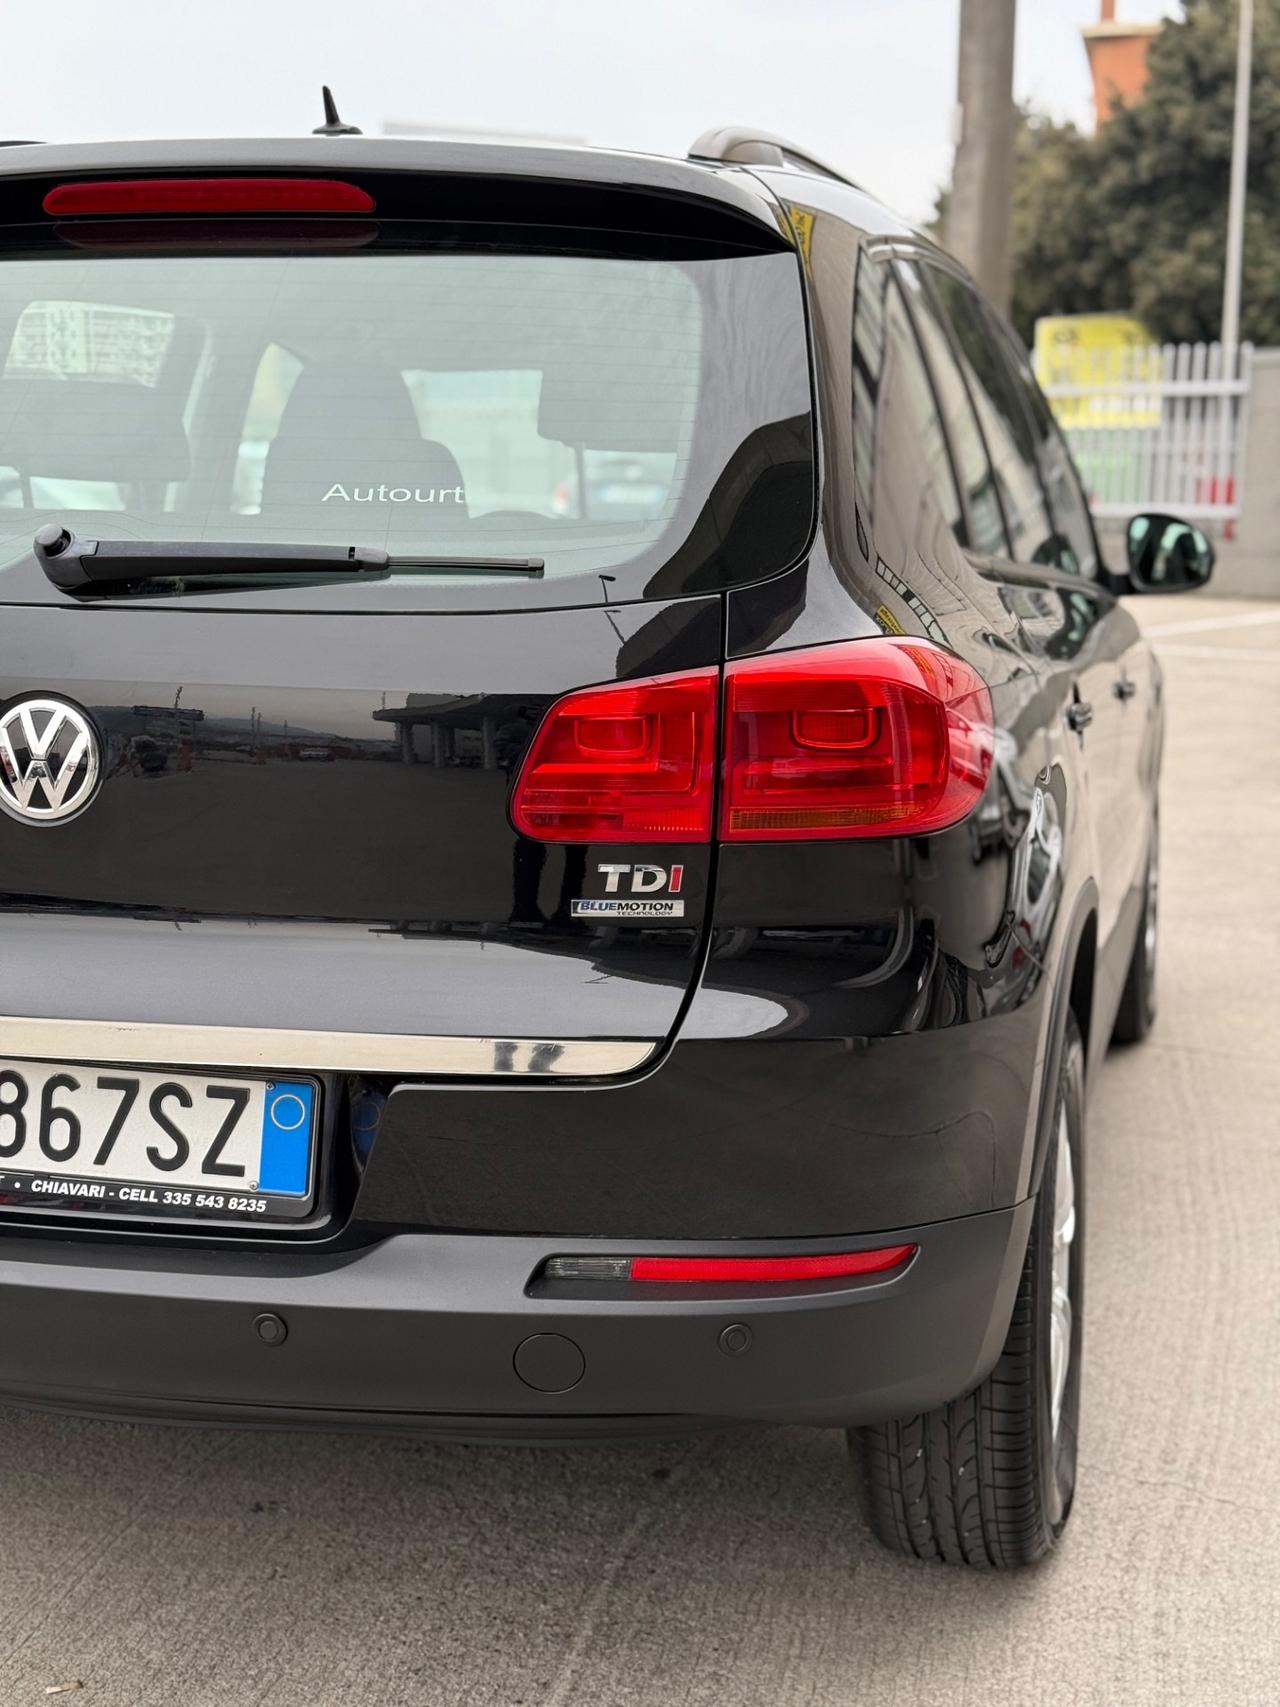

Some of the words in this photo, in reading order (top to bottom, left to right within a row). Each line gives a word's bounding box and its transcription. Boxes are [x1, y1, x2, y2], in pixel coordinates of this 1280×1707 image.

[598, 864, 684, 893] TDI
[580, 902, 675, 911] BLUEMOTION
[0, 1069, 250, 1177] 867SZ
[31, 1180, 105, 1198] CHIAVARI
[119, 1187, 158, 1203] CELL
[163, 1191, 192, 1206] 335
[195, 1194, 224, 1209] 543
[228, 1197, 267, 1213] 8235
